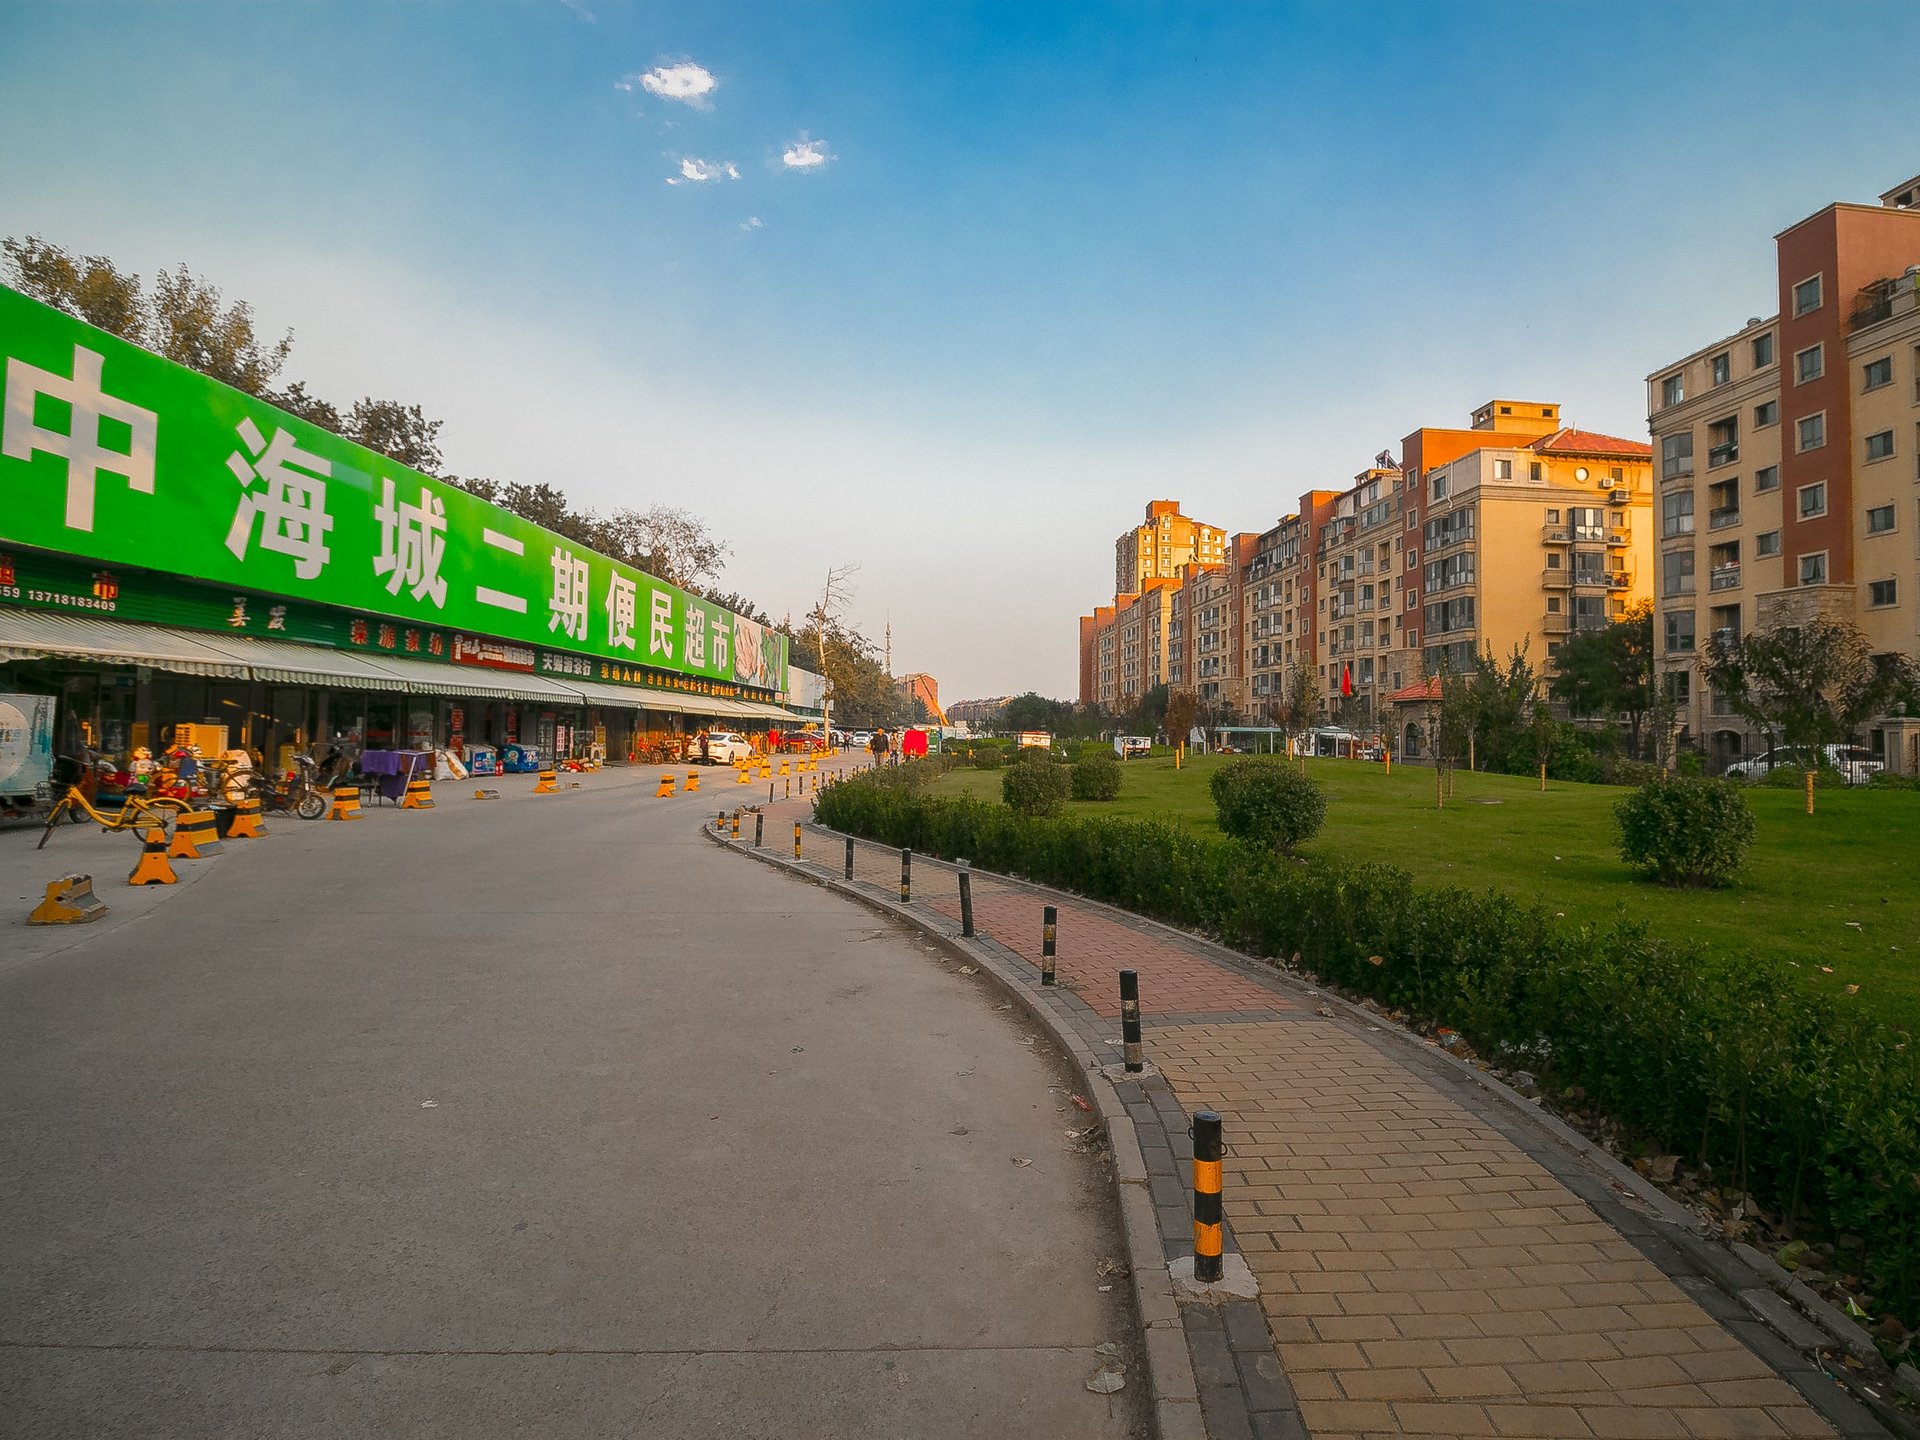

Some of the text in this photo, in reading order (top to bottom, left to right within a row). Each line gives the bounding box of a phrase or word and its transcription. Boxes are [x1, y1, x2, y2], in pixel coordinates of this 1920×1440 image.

[2, 343, 730, 672] 中海城二期便民超市
